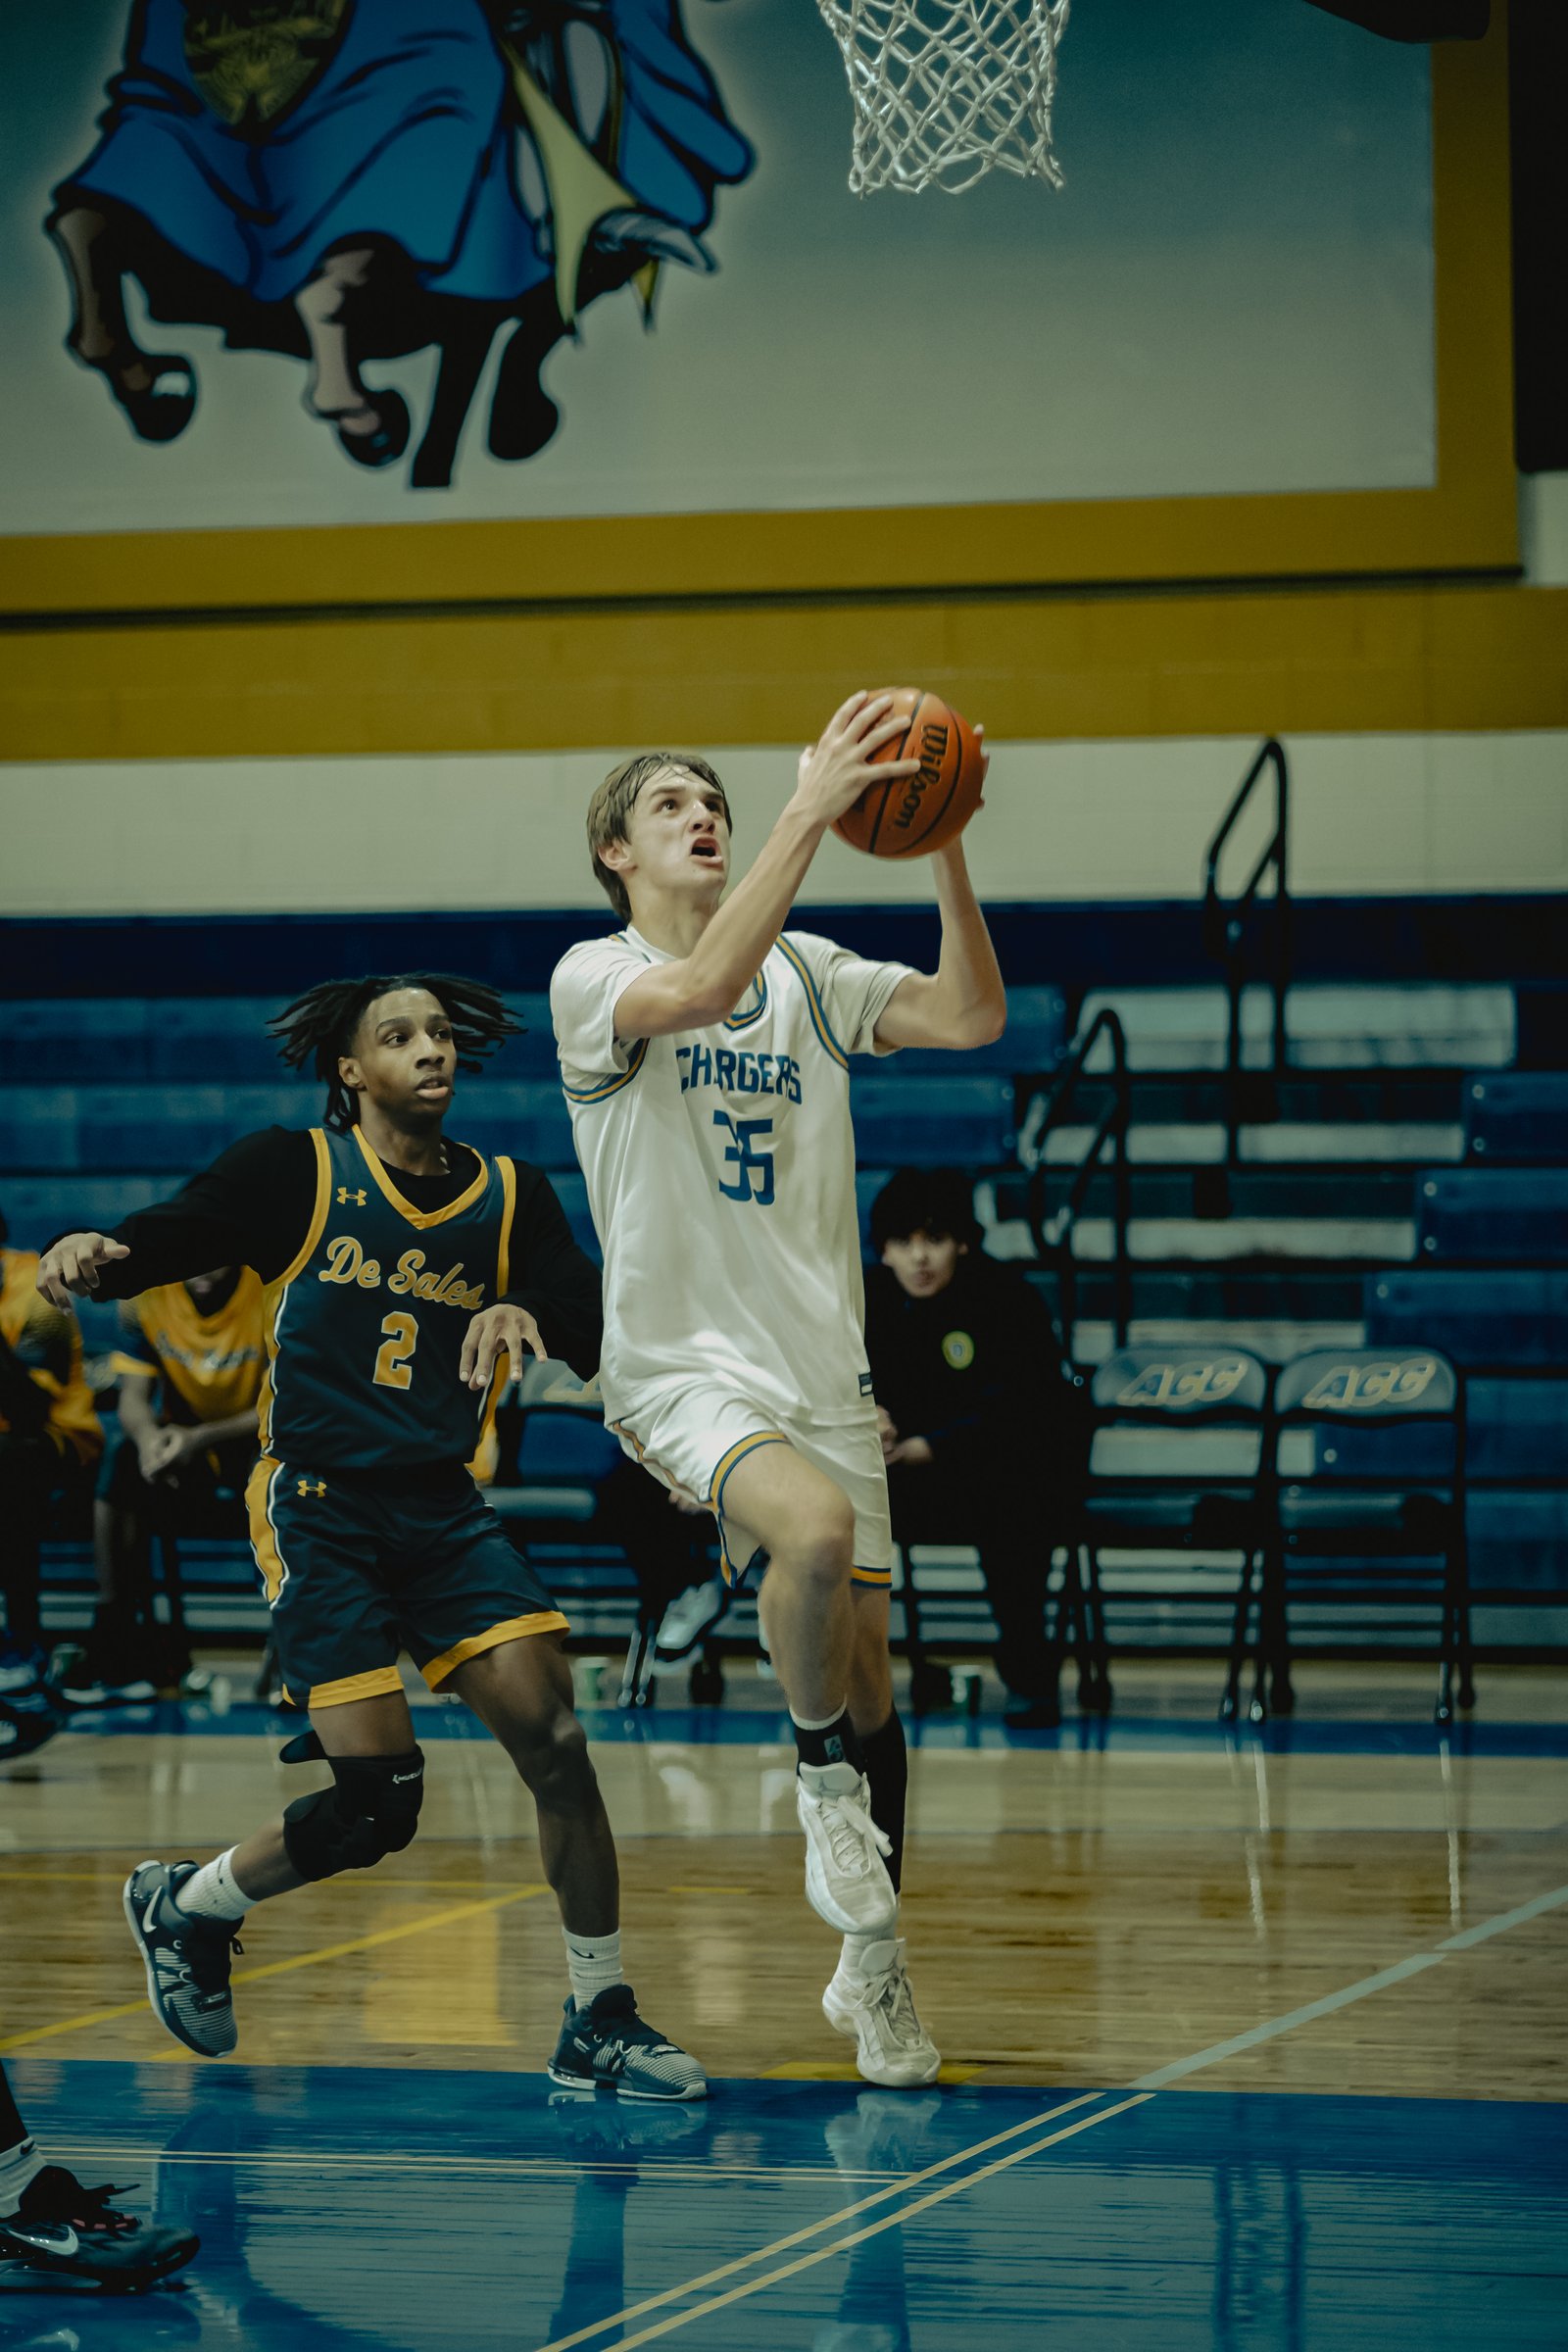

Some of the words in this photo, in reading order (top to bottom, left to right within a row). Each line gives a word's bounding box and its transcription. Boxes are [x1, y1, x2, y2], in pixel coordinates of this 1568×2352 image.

[894, 723, 949, 828] Wilson
[675, 1044, 803, 1104] CHRGERS
[713, 1109, 774, 1205] 35
[318, 1236, 381, 1289] De
[387, 1249, 486, 1310] Sales
[372, 1310, 419, 1391] 2
